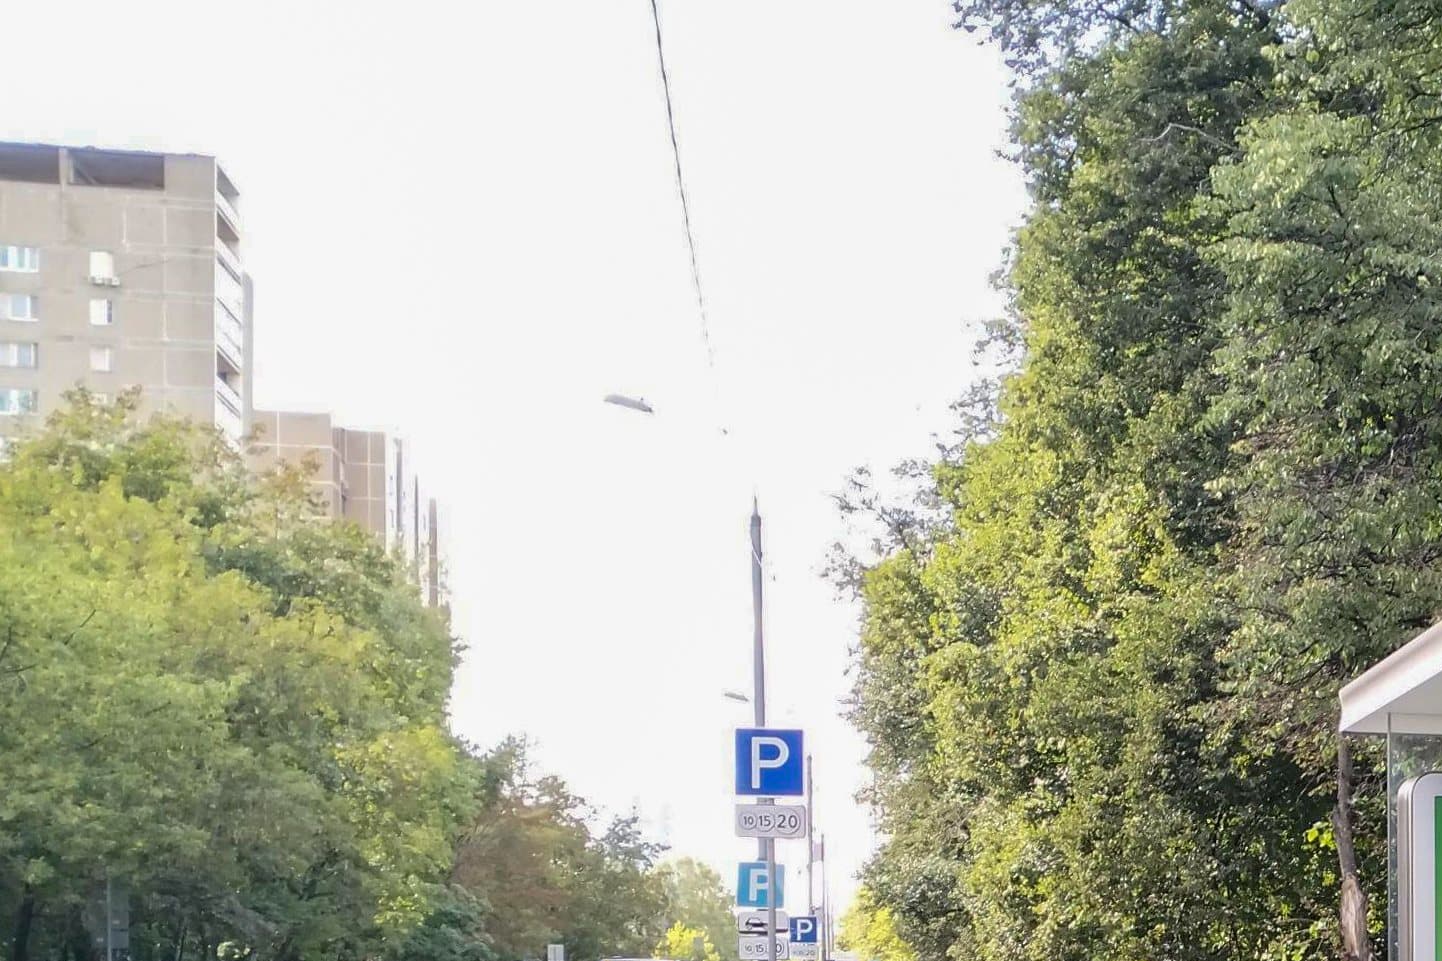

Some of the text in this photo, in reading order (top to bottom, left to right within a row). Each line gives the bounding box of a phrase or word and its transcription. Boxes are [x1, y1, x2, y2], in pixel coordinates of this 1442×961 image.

[751, 736, 790, 789] P
[743, 814, 798, 829] 10 15 20
[796, 919, 813, 941] P
[755, 944, 764, 953] 15
